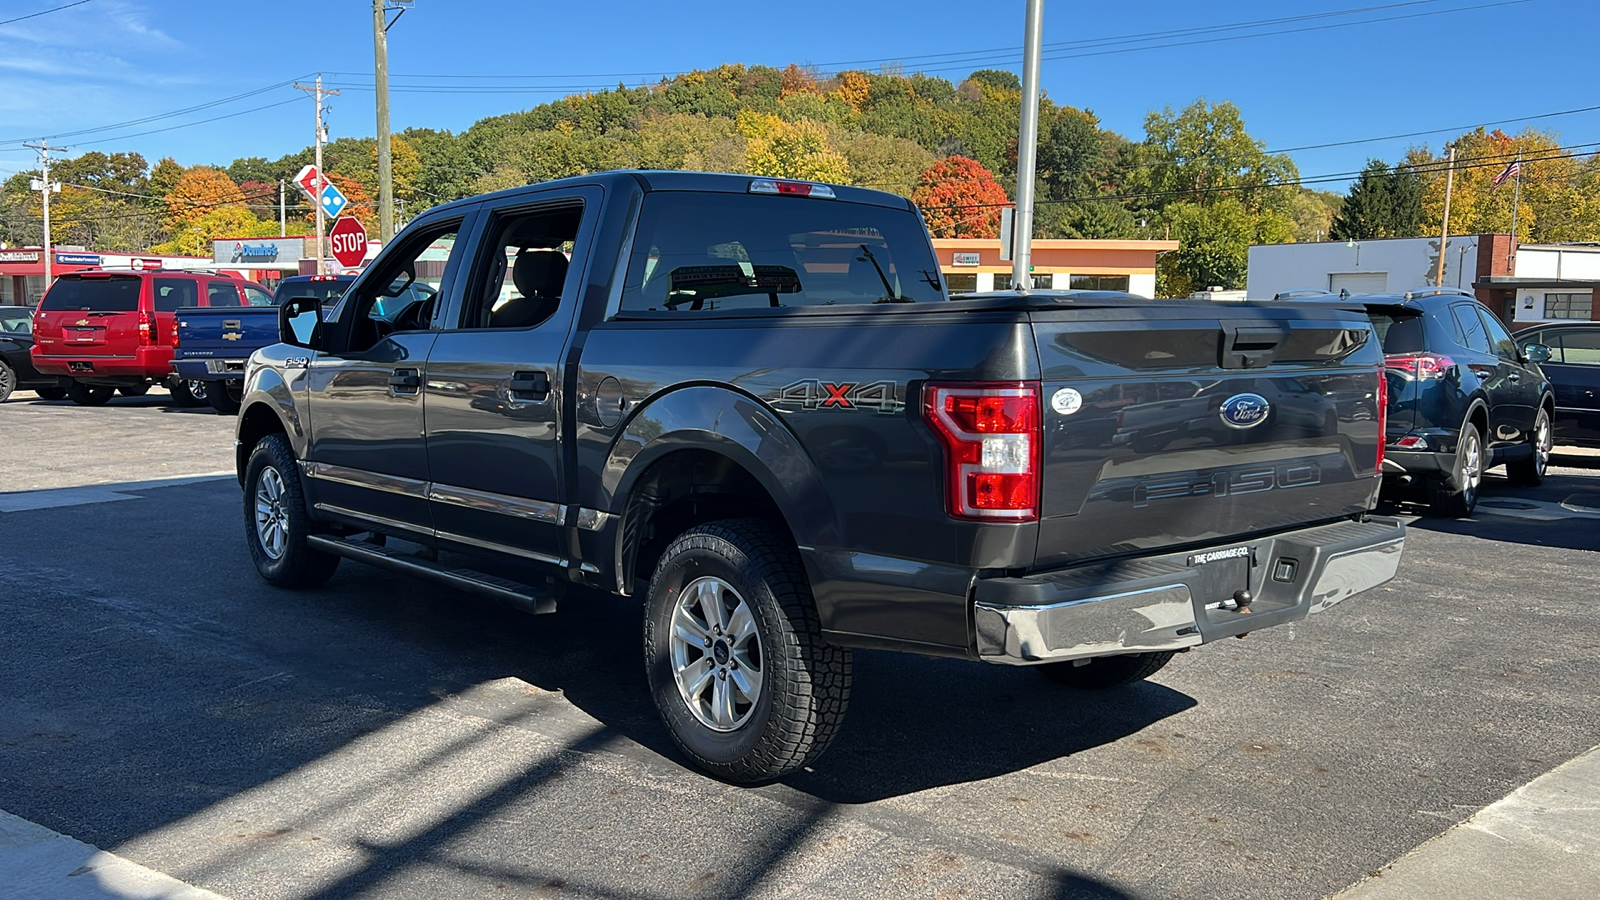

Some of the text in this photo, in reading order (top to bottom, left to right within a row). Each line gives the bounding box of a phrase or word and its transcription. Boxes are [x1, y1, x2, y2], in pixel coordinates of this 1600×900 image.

[242, 243, 279, 256] Domino's
[333, 232, 365, 253] STOP
[1233, 400, 1261, 421] Ford
[1132, 460, 1321, 508] F-150
[1194, 546, 1249, 564] THE CARRIAGE CO.
